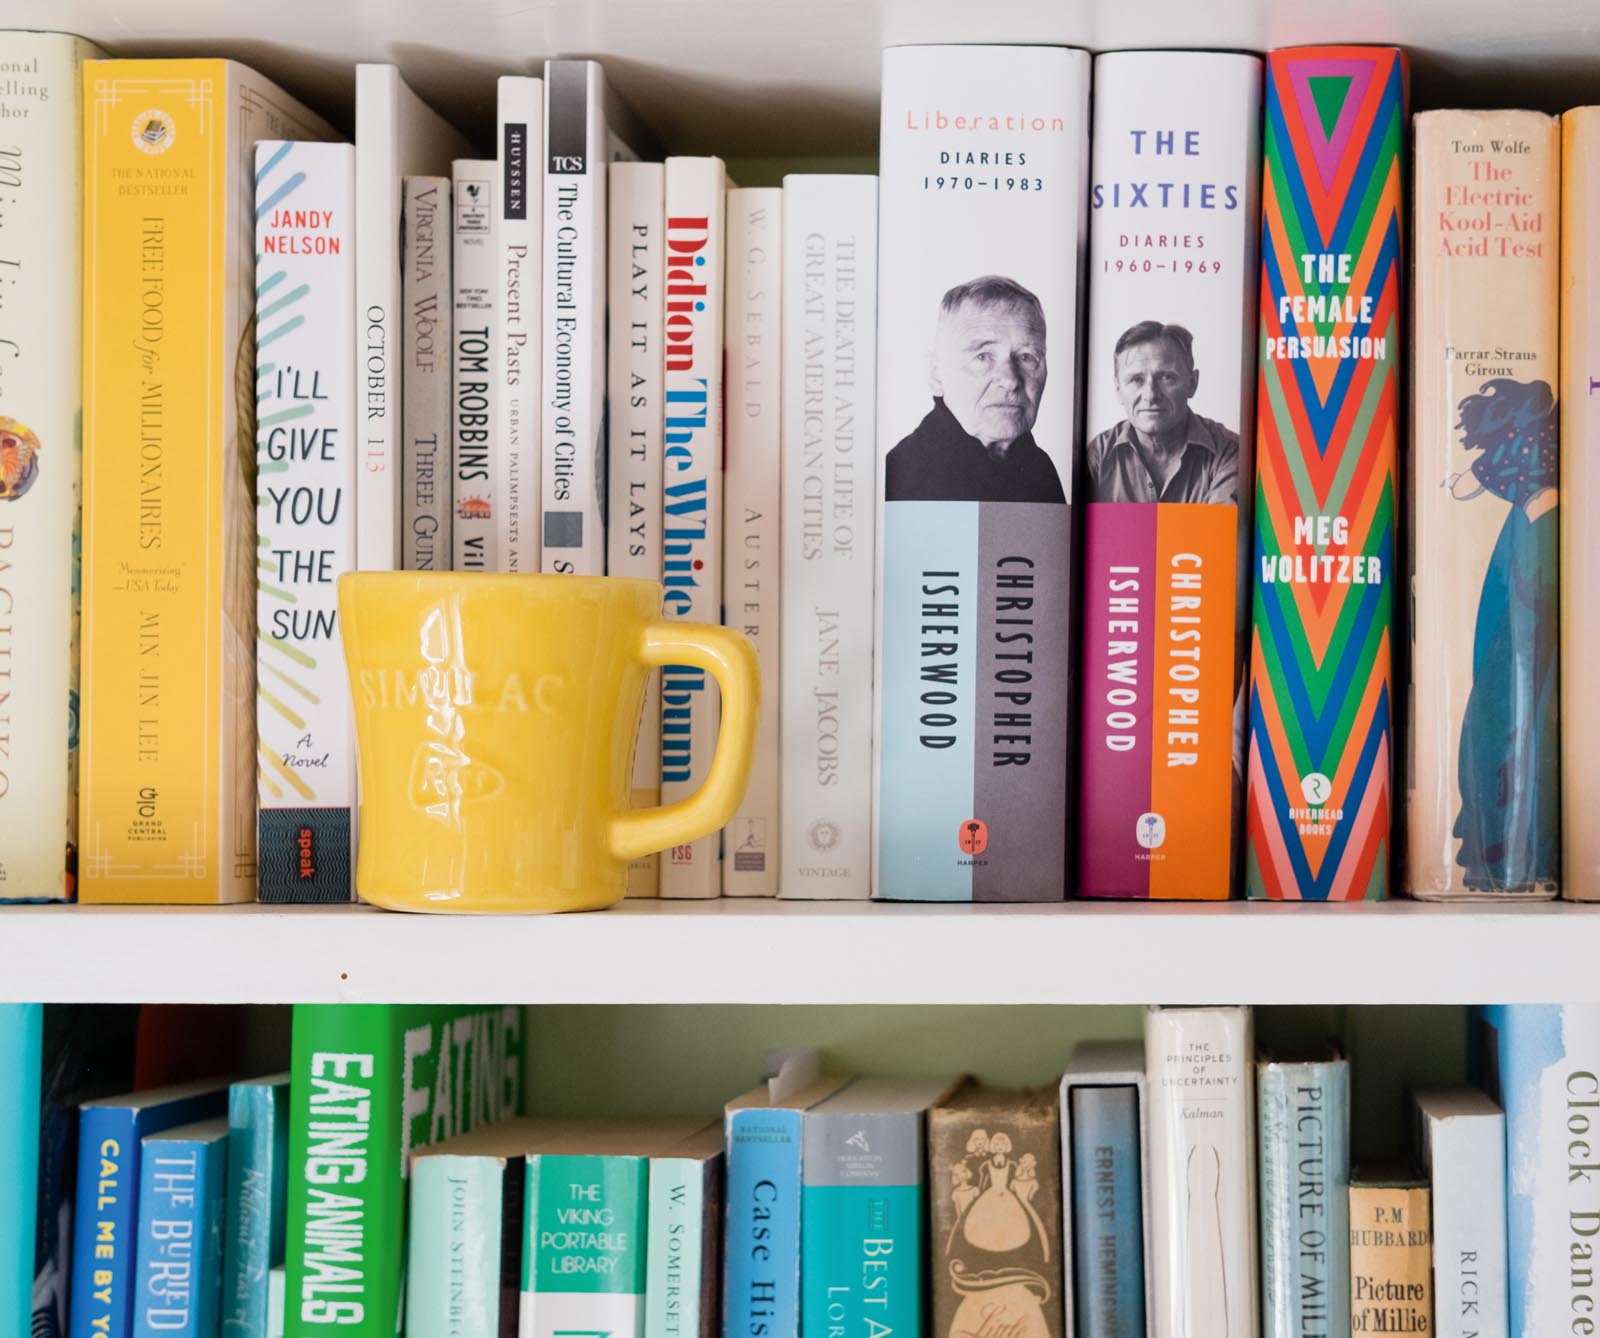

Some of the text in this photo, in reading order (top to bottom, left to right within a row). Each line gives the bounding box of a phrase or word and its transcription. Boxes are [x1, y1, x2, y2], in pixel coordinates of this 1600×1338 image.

[905, 110, 1065, 133] Liberation
[940, 151, 1027, 166] DIARIES
[1130, 130, 1201, 156] THE
[1451, 140, 1532, 154] Tom Wolfe
[510, 132, 521, 210] HUYSSEN
[552, 156, 583, 172] TCS
[1469, 161, 1512, 182] The
[924, 176, 1043, 191] 1970–1983
[1092, 183, 1239, 210] SIXTIES
[1444, 186, 1533, 207] Electric
[270, 210, 333, 230] JANDY
[1438, 211, 1543, 233] Kool-Aid
[263, 235, 341, 256] NELSON
[1119, 234, 1206, 248] DIARIES
[1438, 237, 1544, 258] Acid Test
[412, 187, 438, 374] VIRGINIA WOOLF
[1104, 260, 1222, 274] 1960–1969
[1301, 254, 1352, 284] THE
[506, 244, 528, 386] Present Pasts
[1279, 295, 1373, 324] FEMALE
[458, 326, 489, 373] TOM
[552, 183, 578, 501] The Cultural Economy of Cities
[745, 289, 765, 419] SEBALD
[1266, 336, 1386, 360] PERSUASION
[366, 304, 385, 420] OCTOBER
[1464, 362, 1514, 376] Giroux
[132, 216, 165, 550] FREE FOOD for MILLIONAIRES
[276, 365, 328, 400] I'LL
[628, 223, 649, 557] PLAY IT AS IT LAYS
[801, 232, 825, 561] GREAT AMERICAN CITIES
[832, 236, 856, 561] THE DEATH AND LIFE OF
[266, 427, 338, 461] GIVE
[458, 381, 489, 481] ROBBINS
[413, 432, 437, 507] THREE
[508, 399, 520, 573] URBAN PALIMPSESTS AN
[266, 486, 342, 526] YOU
[662, 216, 708, 783] Didion The White lbum
[1294, 516, 1349, 545] MEG
[271, 549, 336, 583] THE
[463, 536, 485, 572] Vil
[1261, 555, 1382, 585] WOLITZER
[743, 507, 763, 654] AUSTER
[138, 610, 160, 657] MIN
[271, 608, 336, 641] SUN
[919, 571, 961, 750] ISHERWOOD
[992, 556, 1035, 767] CHRISTOPHER
[1105, 566, 1140, 752] ISHERWOOD
[1167, 552, 1203, 768] CHRISTOPHER
[138, 669, 160, 706] JIN
[359, 665, 563, 714] SIMLAC
[813, 605, 840, 787] JANE JACOBS
[137, 720, 159, 762] LEE
[296, 733, 313, 749] A
[281, 751, 329, 769] Novel
[1289, 808, 1344, 820] RIVERHEAD
[1300, 824, 1332, 836] BOOKS
[299, 828, 313, 879] speak
[671, 845, 693, 861] FSG
[798, 867, 851, 878] VINTAGE
[1167, 1054, 1232, 1063] PRINCIPLES
[1189, 1043, 1210, 1051] THE
[1161, 1076, 1238, 1087] UNCERTAINTY
[1192, 1066, 1206, 1074] OF
[400, 1005, 521, 1180] EATING
[1180, 1107, 1224, 1119] Kalman
[301, 1052, 374, 1324] EATING ANIMALS
[568, 1183, 601, 1201] THE
[1095, 1146, 1115, 1222] ERNEST
[447, 1176, 468, 1232] JOHN
[556, 1208, 614, 1226] VIKING
[750, 1179, 778, 1262] Case
[870, 1200, 886, 1231] THE
[1297, 1086, 1327, 1338] PICTURE OF MIL
[1565, 1070, 1600, 1337] Clock Dance
[91, 1138, 120, 1305] CALL ME BY
[1350, 1230, 1428, 1247] HUBBARD
[146, 1151, 198, 1331] THE BURIED
[541, 1232, 628, 1250] PORTABLE
[551, 1256, 619, 1274] LIBRARY
[665, 1184, 686, 1336] W. SOMERSET
[862, 1238, 894, 1310] BEST
[1355, 1275, 1425, 1301] Picture
[1460, 1251, 1479, 1316] RICK
[1352, 1307, 1427, 1332] of Millie
